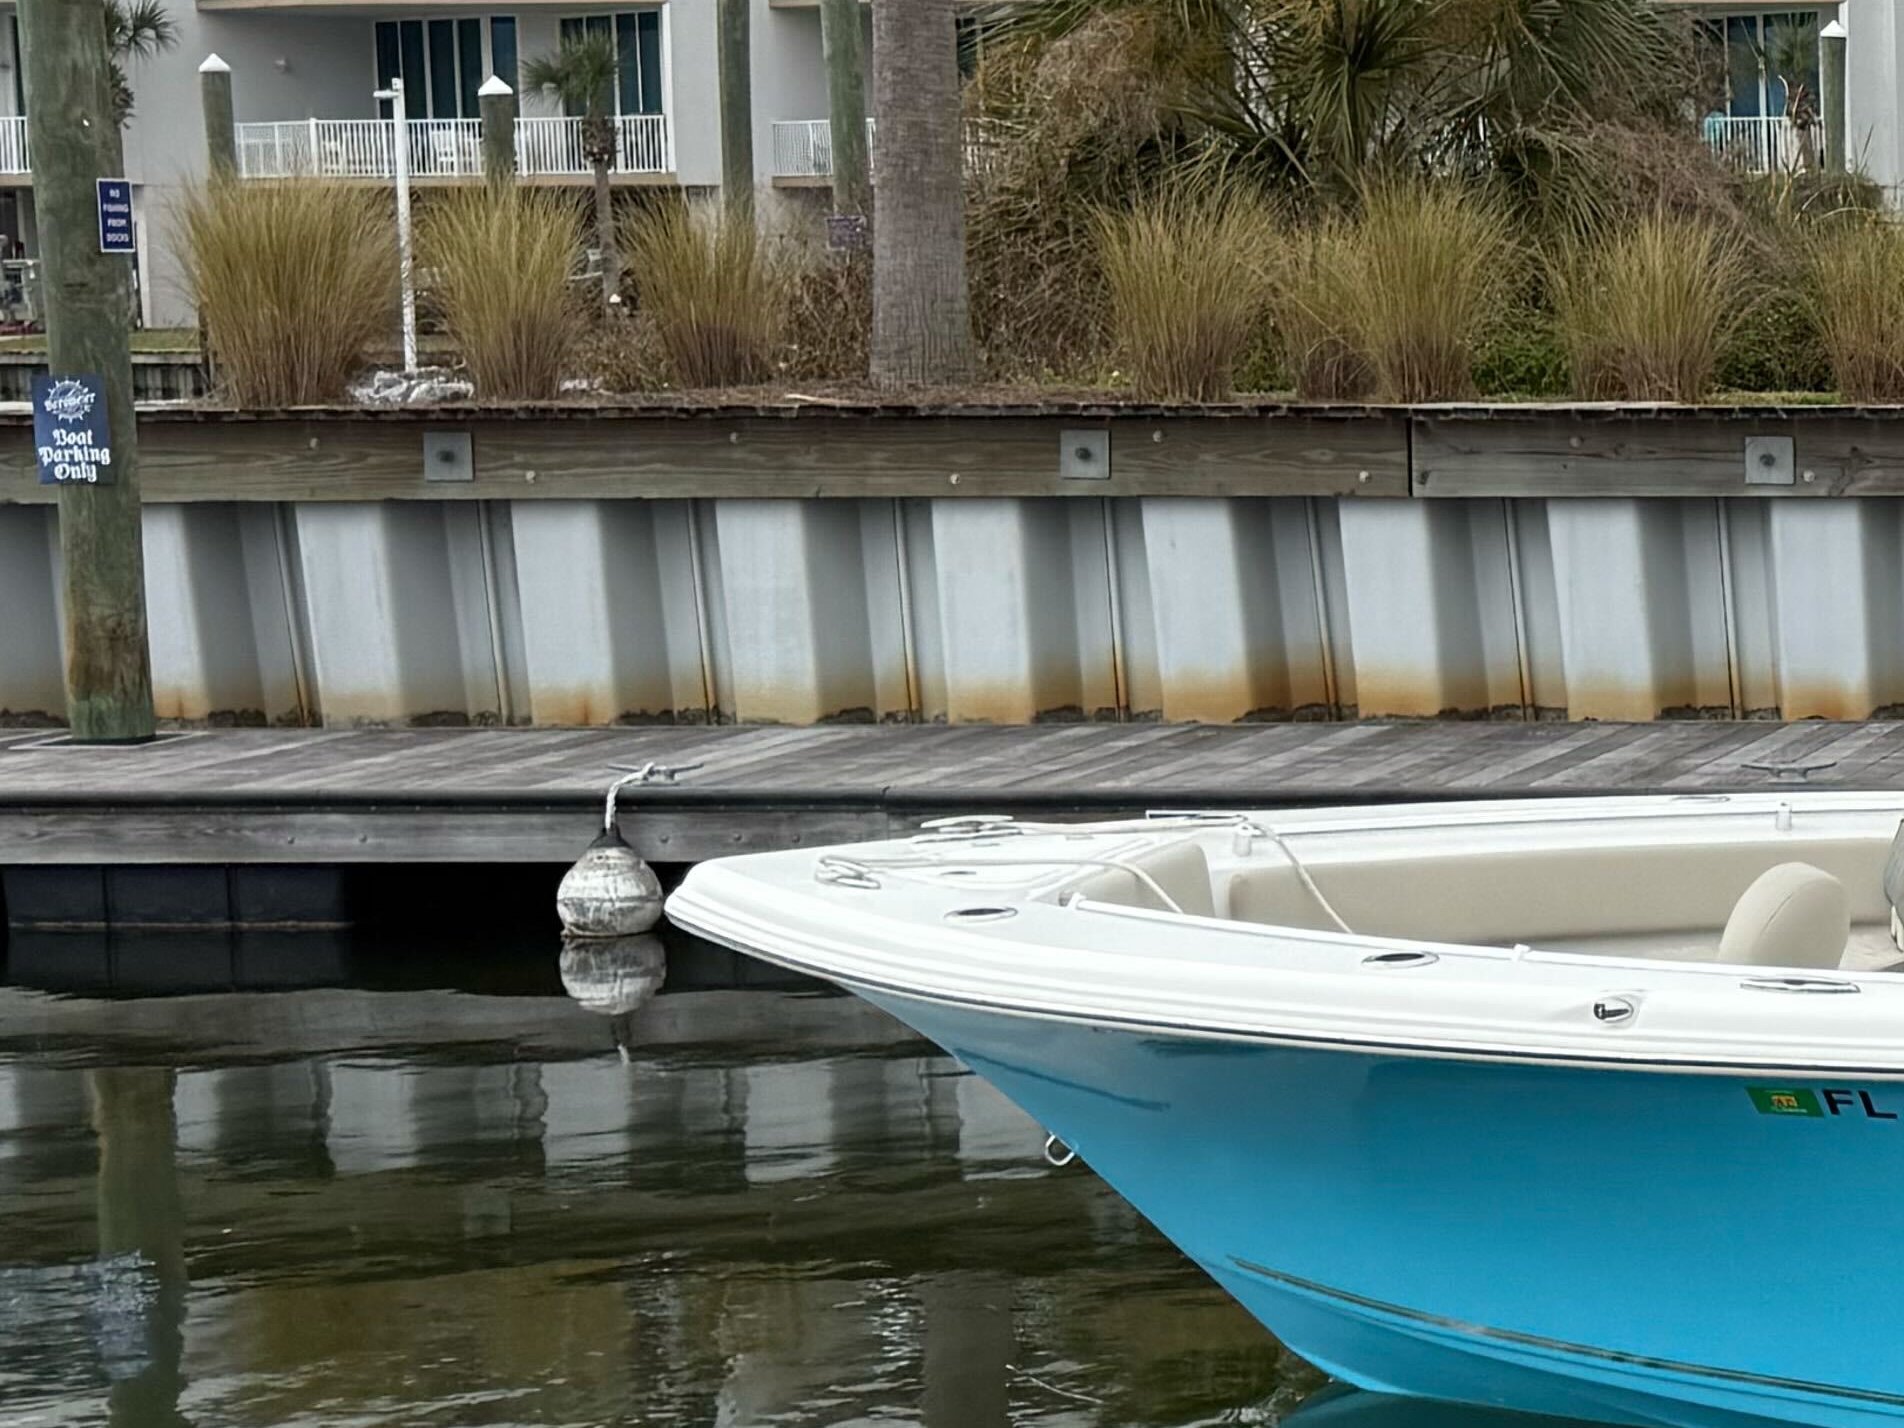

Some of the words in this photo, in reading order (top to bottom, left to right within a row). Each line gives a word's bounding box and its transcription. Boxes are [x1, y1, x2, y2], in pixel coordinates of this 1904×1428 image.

[52, 429, 93, 446] Boat
[38, 446, 111, 467] Parking
[54, 462, 97, 483] Only
[1822, 1089, 1898, 1120] FL
